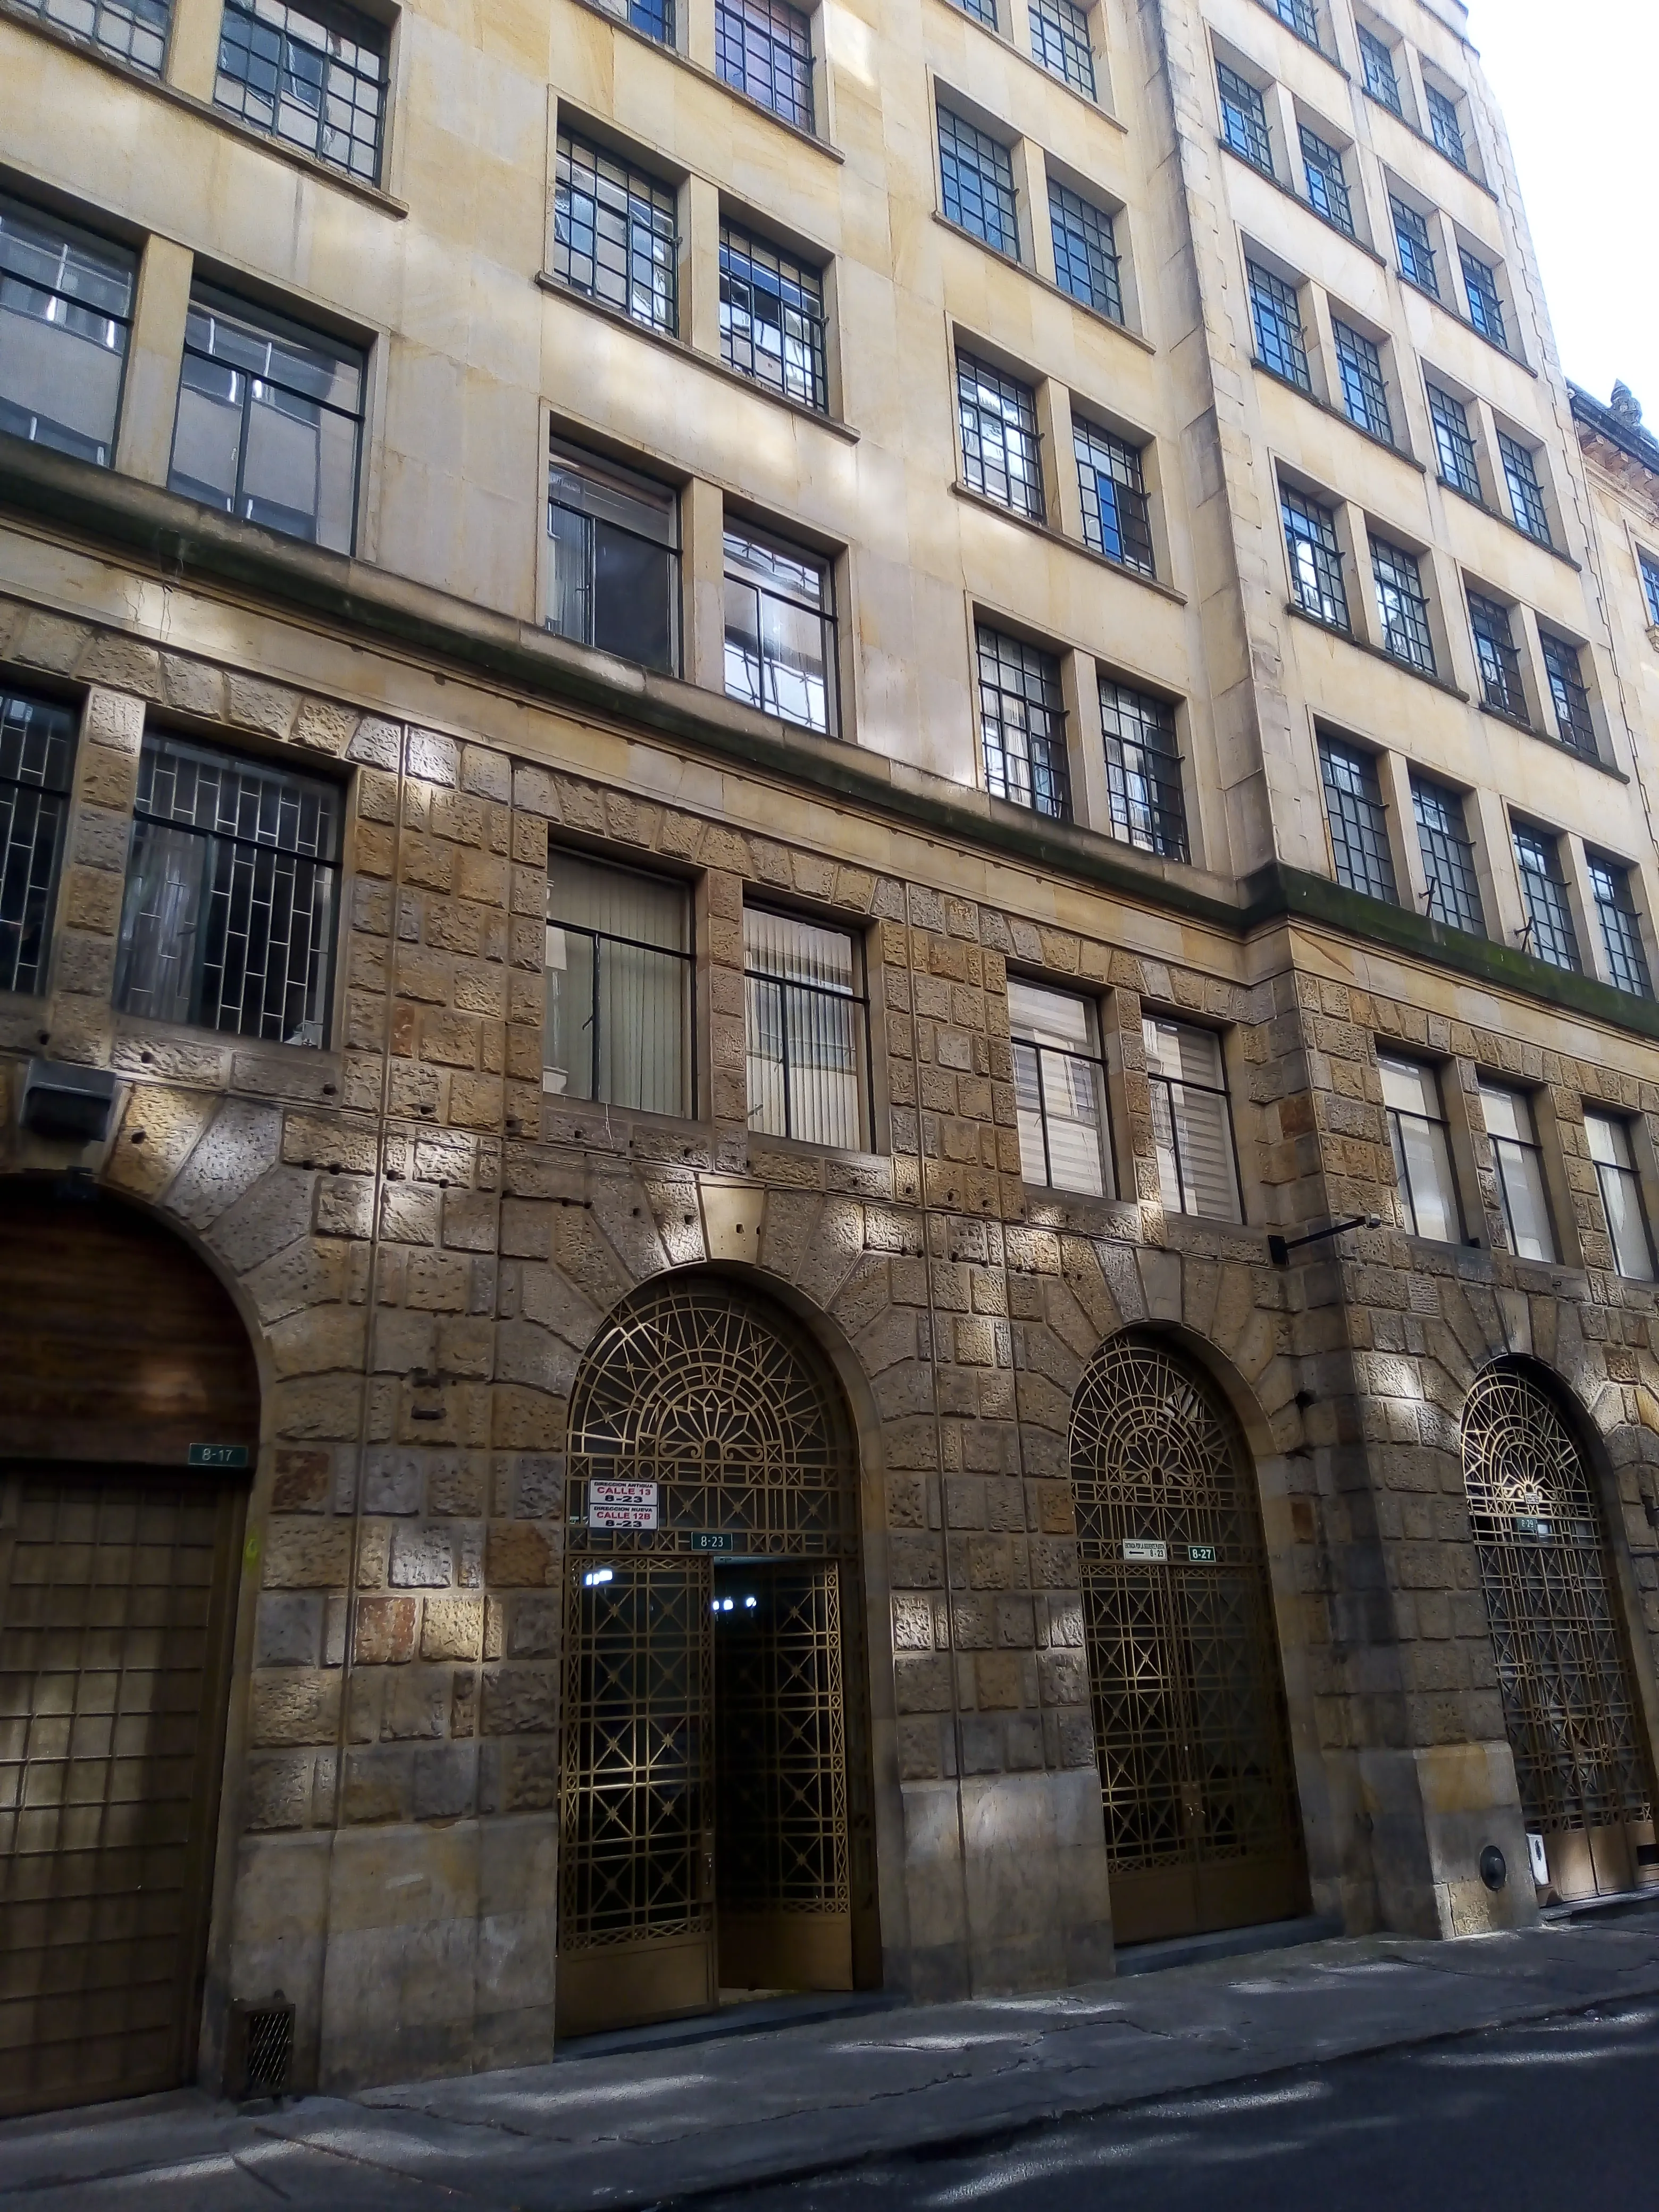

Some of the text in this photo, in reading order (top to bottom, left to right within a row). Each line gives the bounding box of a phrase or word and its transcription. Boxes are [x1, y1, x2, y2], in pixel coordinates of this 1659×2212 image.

[202, 1448, 233, 1461] 8-17
[701, 1536, 724, 1547] 8-23
[1192, 1549, 1211, 1559] 8-27
